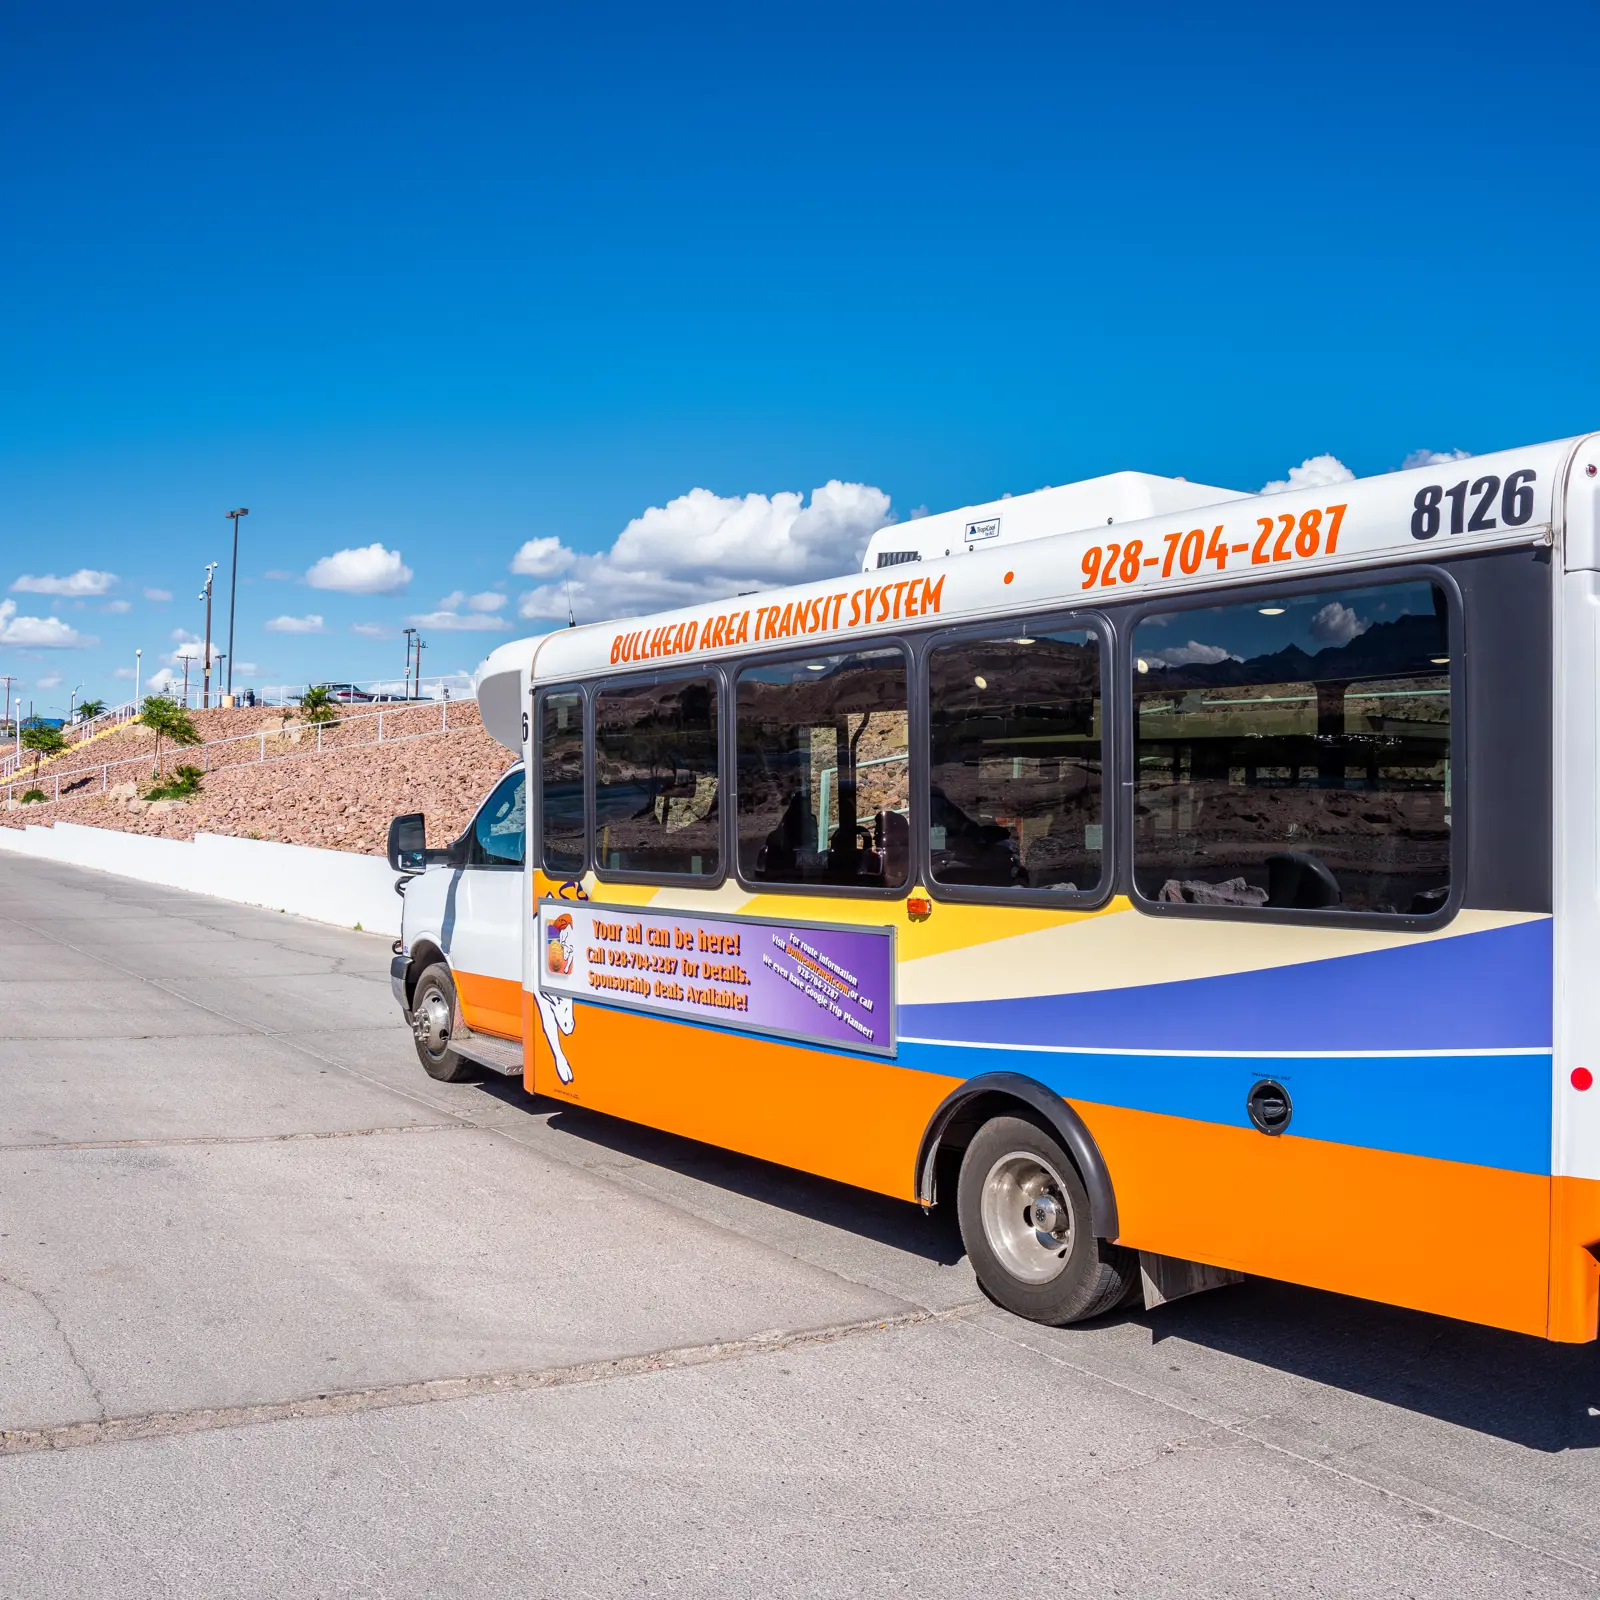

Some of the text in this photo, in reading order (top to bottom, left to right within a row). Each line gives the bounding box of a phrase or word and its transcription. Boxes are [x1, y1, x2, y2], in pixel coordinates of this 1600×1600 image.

[1411, 469, 1537, 540] 8126
[1081, 503, 1348, 590] 928-704-2287
[610, 574, 946, 665] BULLHEAD AREA TRANSIT SYSTEM
[586, 946, 751, 985] Call 928-704-2287 for Details.
[592, 919, 741, 956] Your ad can be here!
[789, 933, 858, 988] For route information
[587, 969, 748, 1012] Sponsorship deals Available!
[762, 953, 874, 1041] We even have Google Trip Planner!
[772, 934, 786, 952] Visit
[850, 990, 859, 1003] or
[859, 996, 874, 1013] call
[797, 965, 839, 1002] 928-704-2287
